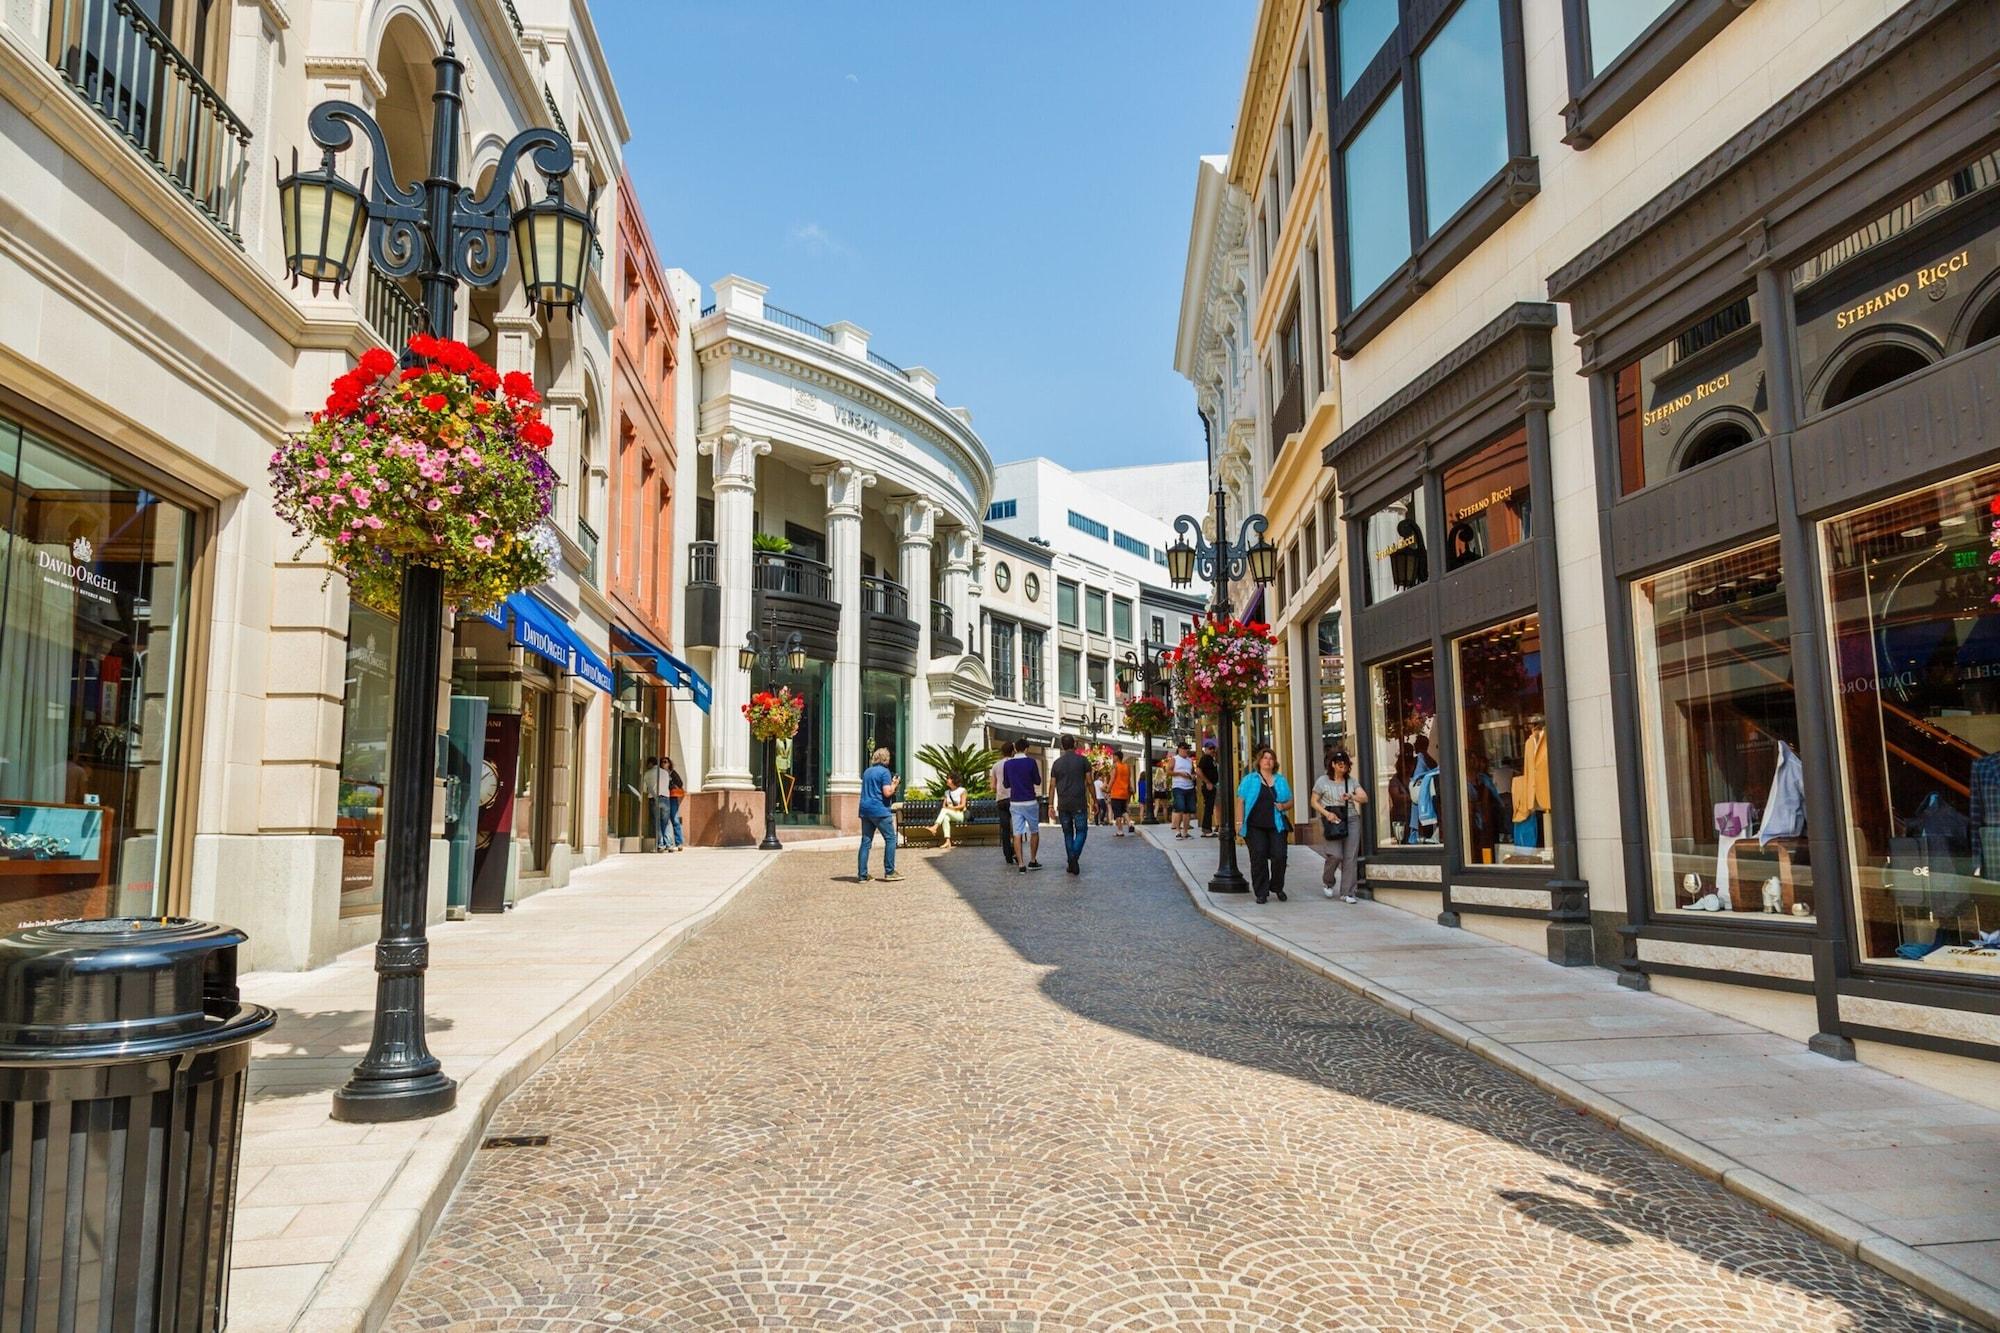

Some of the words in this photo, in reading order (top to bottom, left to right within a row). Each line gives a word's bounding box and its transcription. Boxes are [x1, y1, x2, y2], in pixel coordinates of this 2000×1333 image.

[1836, 283, 1910, 329] STEFANO
[1917, 251, 1969, 290] RICCI
[1643, 394, 1692, 426] STEFANO
[1696, 373, 1730, 400] RICCI
[1459, 498, 1489, 520] STEFANO
[1491, 486, 1512, 504] RICCI
[1954, 551, 1977, 568] EXIT
